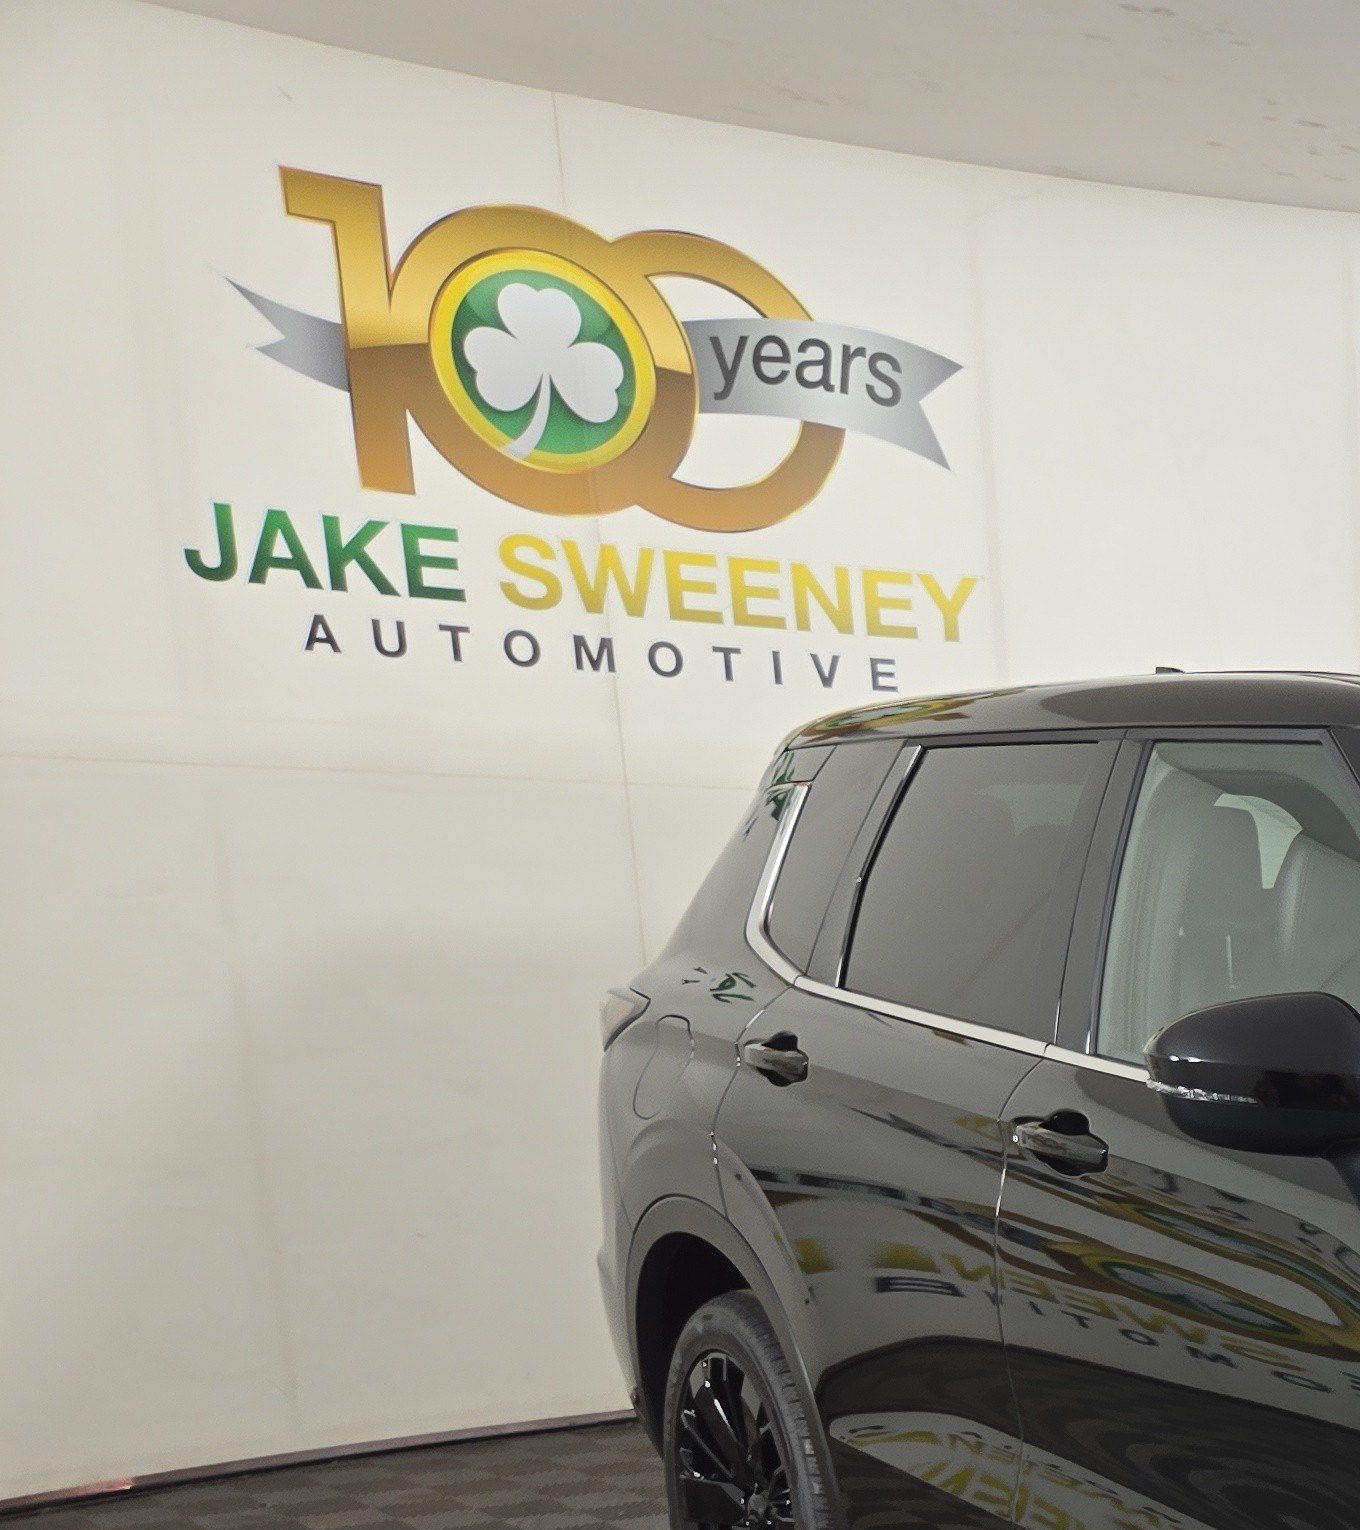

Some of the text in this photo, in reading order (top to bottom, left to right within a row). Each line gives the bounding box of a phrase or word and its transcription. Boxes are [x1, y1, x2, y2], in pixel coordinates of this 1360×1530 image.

[279, 165, 904, 533] 100 years
[184, 500, 980, 643] JAKE SWEENEY
[305, 612, 900, 693] AUTOMOTIVE
